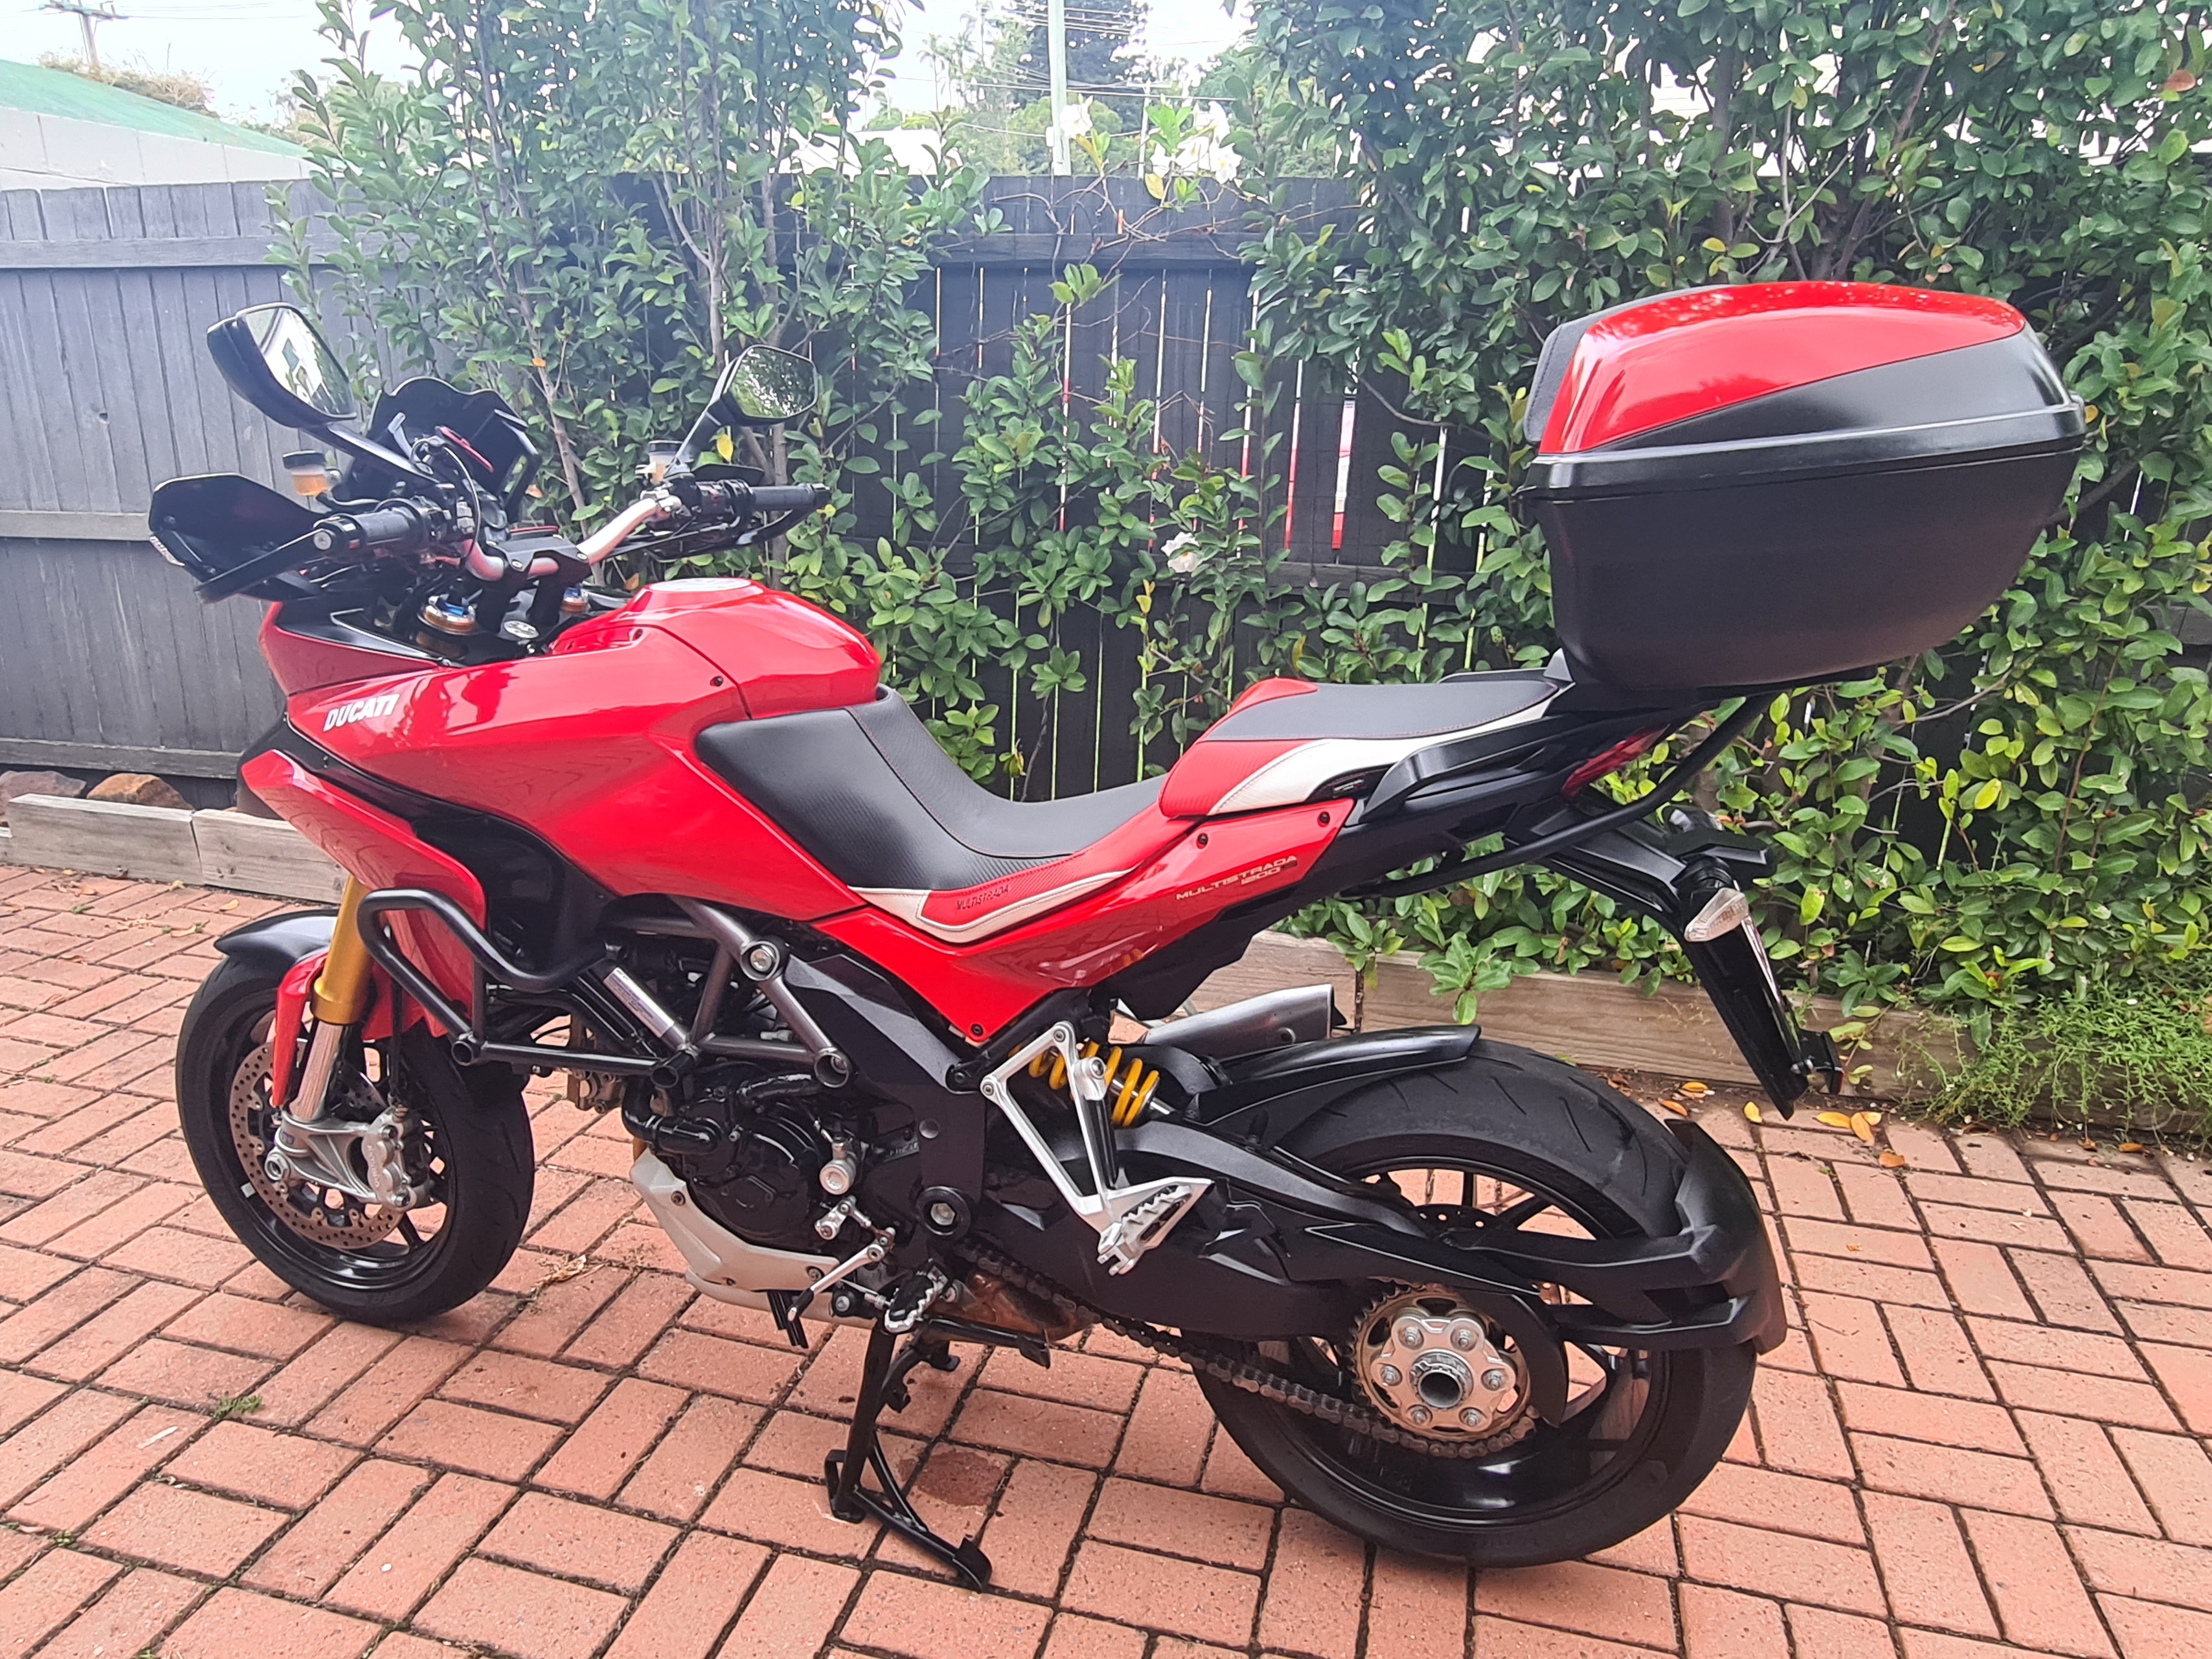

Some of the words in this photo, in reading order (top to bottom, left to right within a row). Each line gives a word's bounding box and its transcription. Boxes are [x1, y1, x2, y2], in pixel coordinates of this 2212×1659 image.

[323, 693, 400, 732] DUCATI
[1176, 855, 1297, 900] MULTISTRADA
[1240, 867, 1282, 885] 1200
